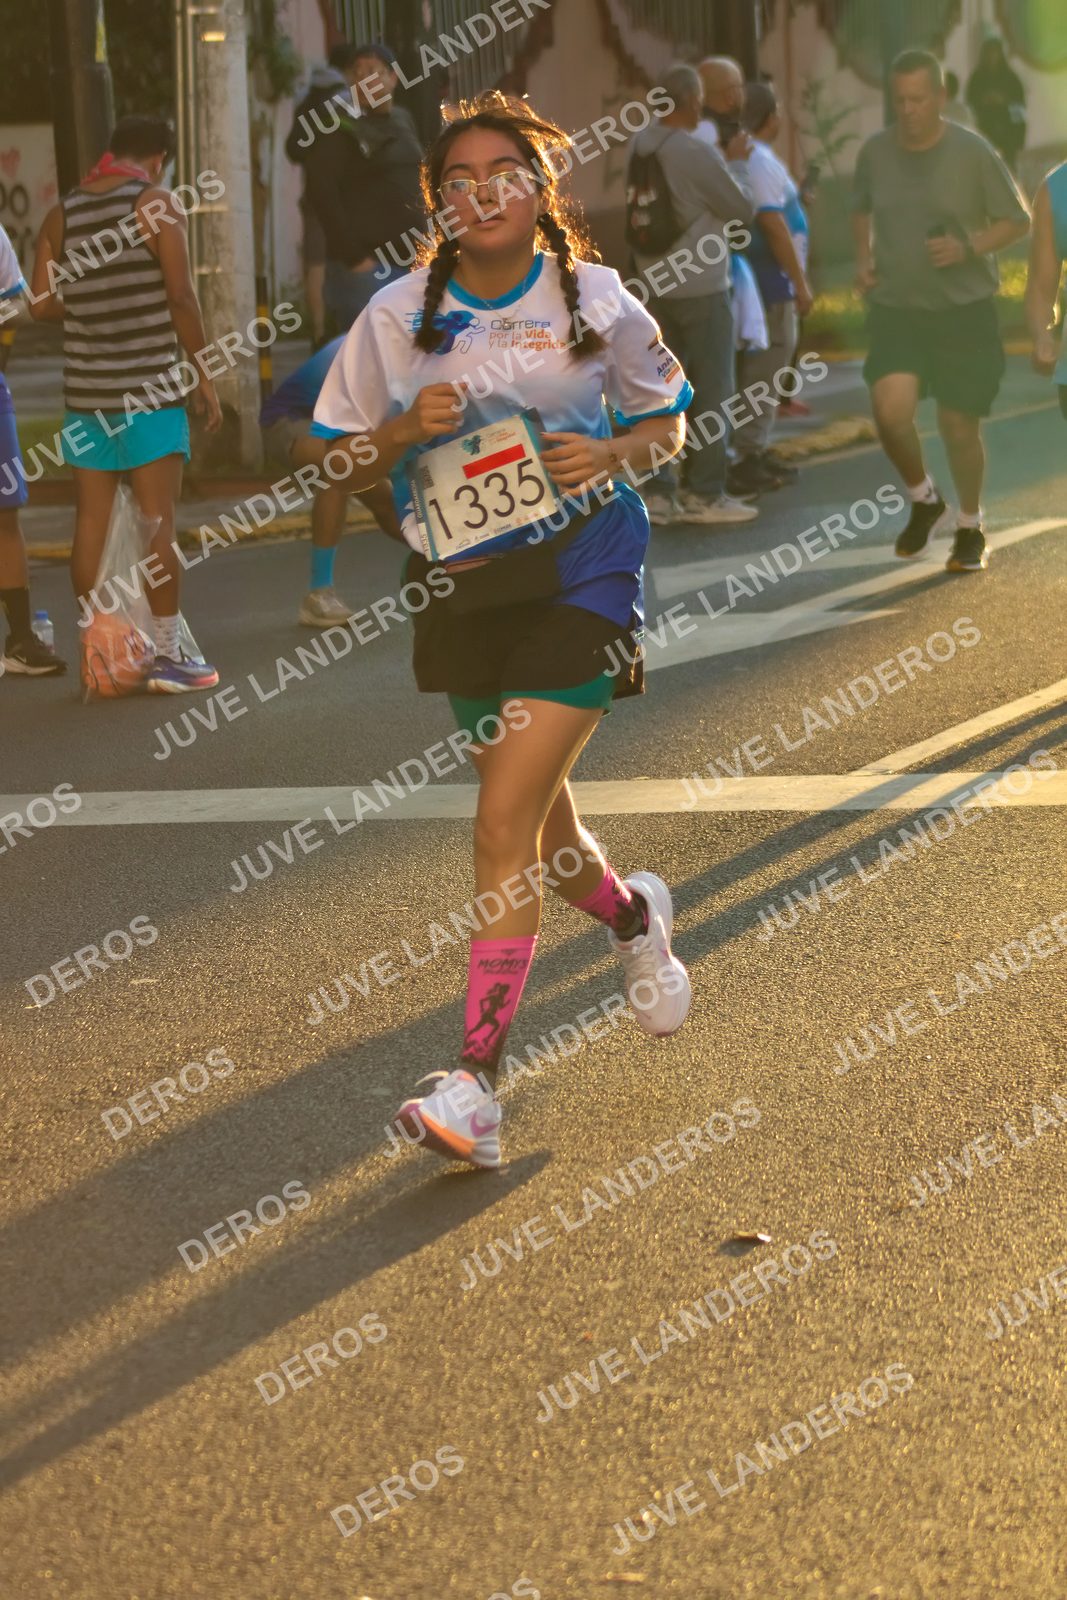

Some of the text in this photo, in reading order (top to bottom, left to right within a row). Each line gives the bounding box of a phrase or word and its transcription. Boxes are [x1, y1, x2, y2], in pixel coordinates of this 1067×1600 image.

[491, 319, 551, 331] Carrera
[489, 332, 509, 341] por
[525, 328, 552, 339] Vida
[429, 458, 545, 540] 1335
